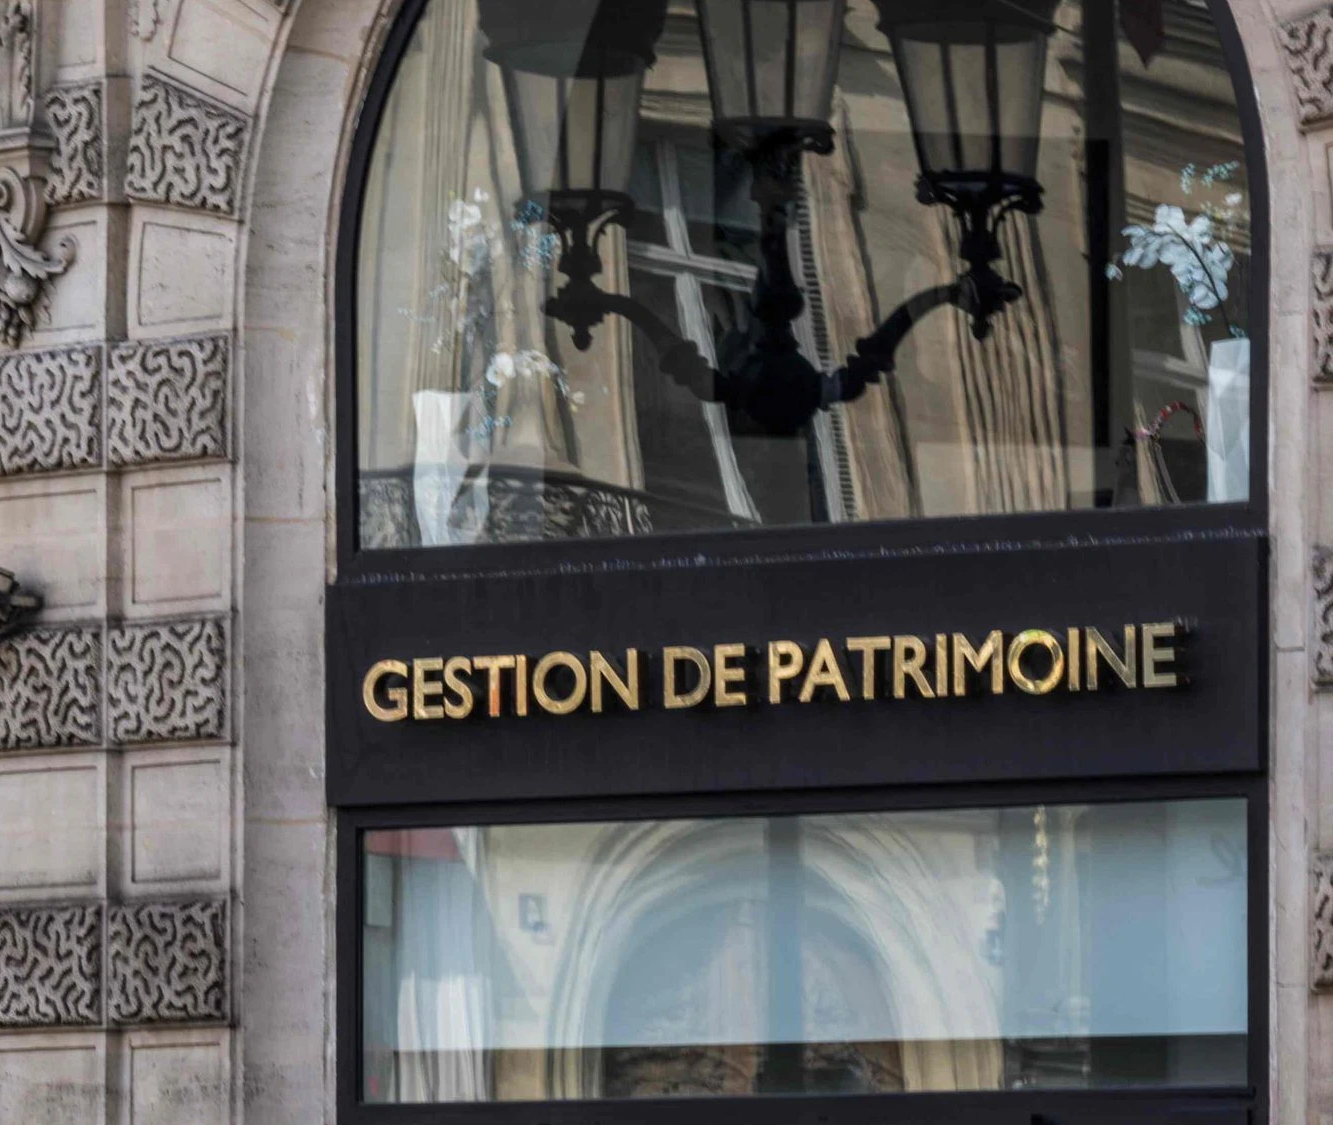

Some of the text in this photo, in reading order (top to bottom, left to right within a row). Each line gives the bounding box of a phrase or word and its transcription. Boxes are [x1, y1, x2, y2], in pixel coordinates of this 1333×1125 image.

[362, 621, 1178, 722] GESTION DE PATRIMOINE
